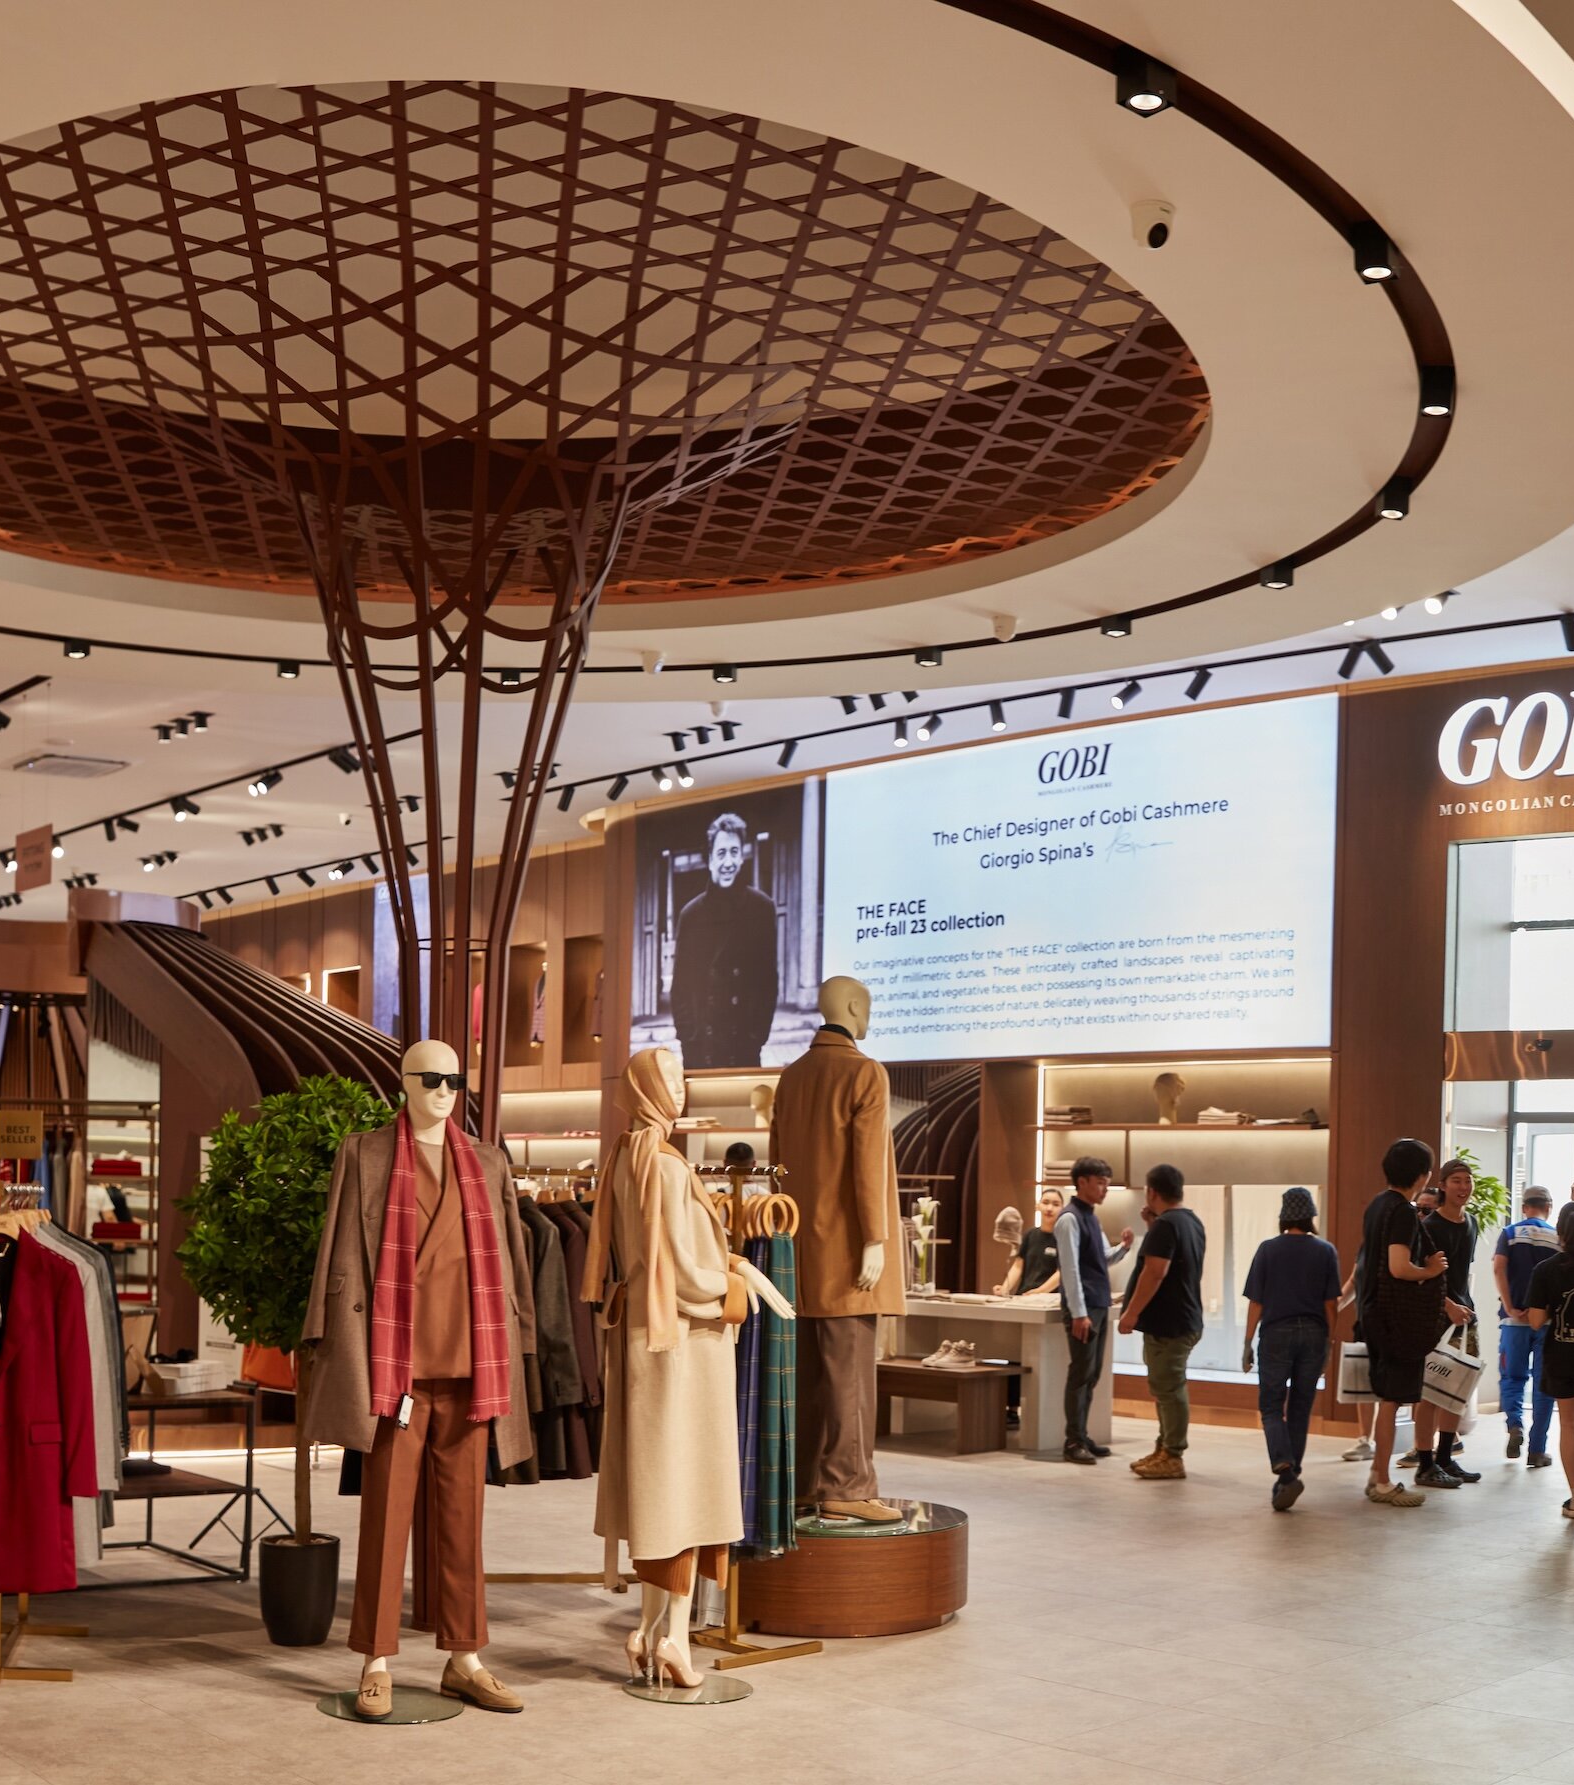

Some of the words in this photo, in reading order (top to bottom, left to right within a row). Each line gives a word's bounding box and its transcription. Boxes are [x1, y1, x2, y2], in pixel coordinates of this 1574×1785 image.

[1038, 743, 1113, 784] GOBI
[1439, 795, 1555, 818] MONGOLIAN
[933, 831, 958, 847] The
[963, 822, 1002, 843] Chief
[1006, 815, 1075, 839] Designer
[1080, 810, 1095, 828] of
[1100, 805, 1137, 825] Gobi
[1143, 798, 1228, 820] Cashmere
[980, 849, 1034, 870] Giorgio
[1038, 842, 1093, 865] Spina's
[857, 904, 884, 920] THE
[889, 900, 926, 917] FACE
[856, 919, 906, 942] pre-fall
[910, 920, 926, 935] 23
[931, 912, 1004, 932] collection
[853, 960, 870, 970] Our
[872, 954, 924, 970] imaginative
[927, 951, 969, 965] concepts
[972, 951, 984, 960] for
[987, 948, 1003, 959] the
[1065, 939, 1115, 953] collection
[1119, 941, 1135, 949] are
[1139, 937, 1163, 948] born
[1167, 934, 1193, 945] from
[1197, 932, 1215, 944] the
[1219, 928, 1294, 942] mesmerizing
[889, 973, 898, 984] of
[903, 970, 950, 982] millimetric
[956, 967, 986, 979] dunes.
[993, 966, 1021, 976] These
[1027, 961, 1075, 974] intricately
[1081, 958, 1118, 971] crafted
[1124, 955, 1184, 968] landscapes
[1190, 953, 1223, 963] reveal
[1229, 949, 1294, 962] captivating
[888, 990, 921, 1001] animal,
[922, 988, 939, 999] and
[941, 986, 989, 1000] vegetative
[992, 983, 1018, 995] faces,
[1021, 981, 1043, 992] each
[1047, 977, 1102, 993] possessing
[1105, 977, 1116, 987] its
[1119, 977, 1142, 986] own
[1144, 973, 1207, 985] remarkable
[1209, 970, 1248, 981] charm.
[1251, 968, 1270, 979] We
[1273, 967, 1294, 977] aim
[896, 1007, 911, 1017] the
[913, 1005, 944, 1016] hidden
[947, 1002, 994, 1014] intricacies
[996, 1000, 1006, 1011] of
[1044, 996, 1091, 1009] delicately
[1095, 995, 1137, 1006] weaving
[1140, 991, 1198, 1003] thousands
[1200, 990, 1210, 1000] of
[1211, 990, 1251, 1001] strings
[1252, 986, 1294, 997] around
[902, 1024, 920, 1035] and
[921, 1021, 971, 1035] embracing
[973, 1019, 988, 1029] the
[990, 1016, 1035, 1031] profound
[1037, 1015, 1062, 1028] unity
[1064, 1015, 1084, 1025] that
[1086, 1013, 1116, 1024] exists
[1118, 1011, 1150, 1022] within
[1153, 1012, 1172, 1021] our
[1173, 1009, 1210, 1020] shared
[1213, 1007, 1248, 1020] reality.
[0, 1135, 37, 1144] SELLER
[6, 1125, 30, 1134] BEST
[1426, 1360, 1453, 1379] GOBI
